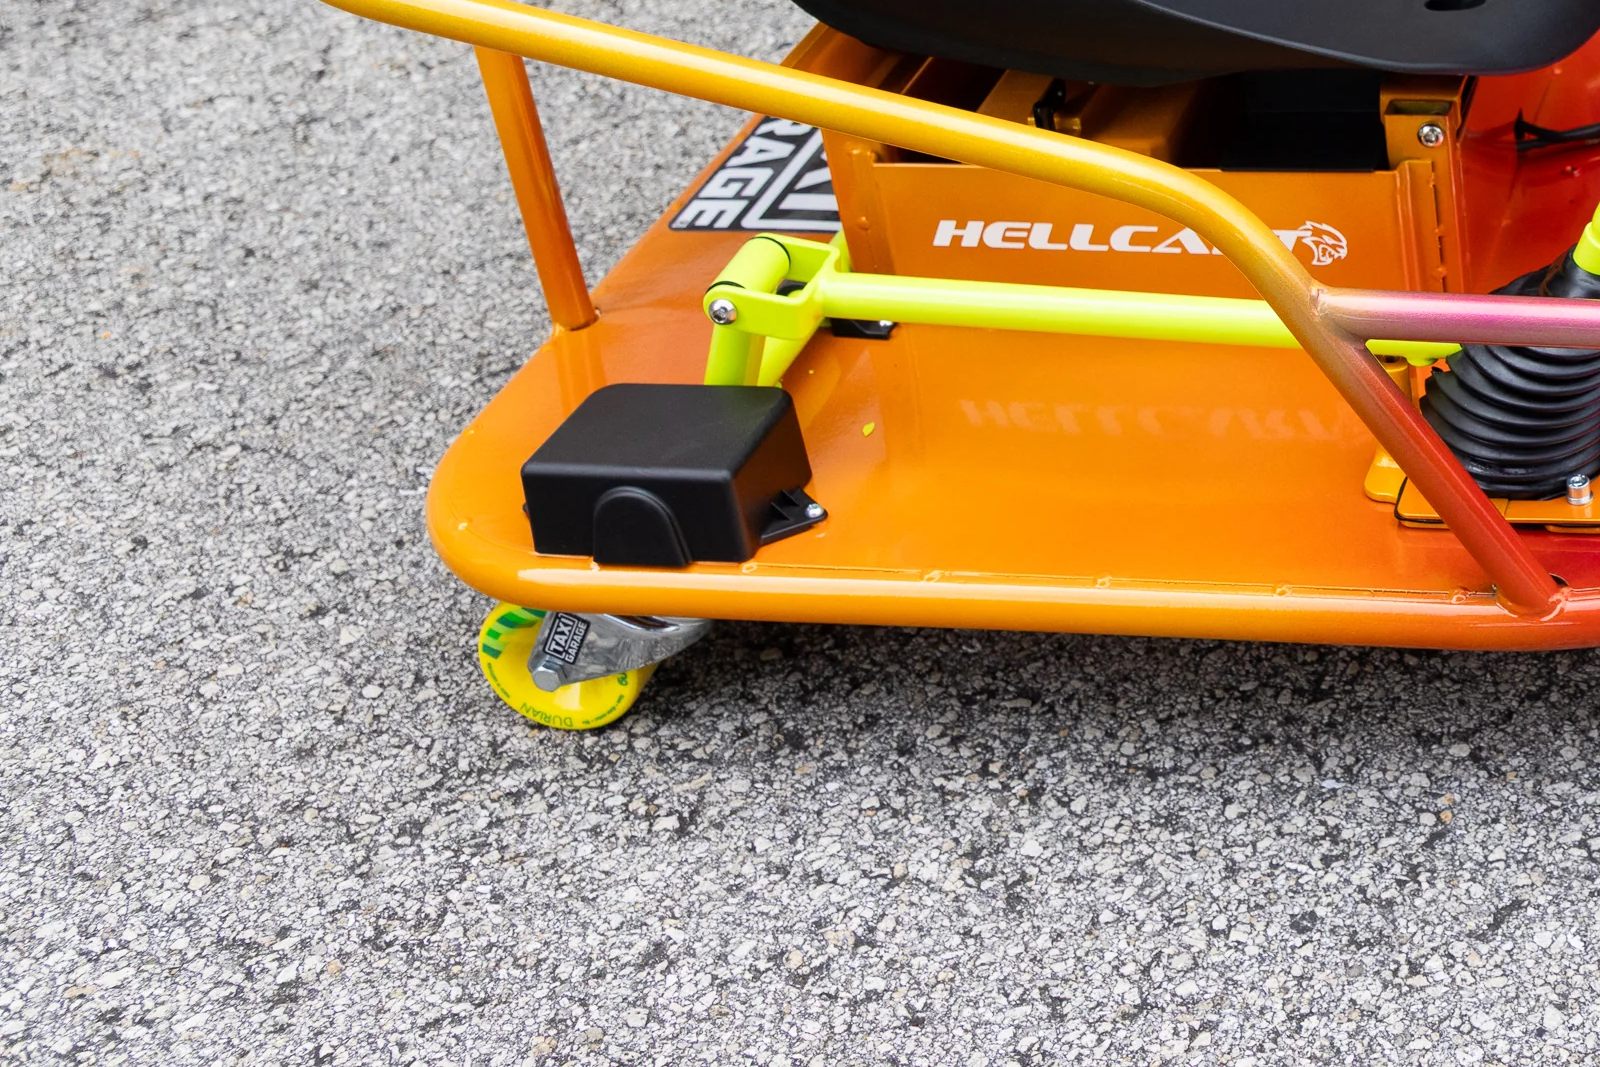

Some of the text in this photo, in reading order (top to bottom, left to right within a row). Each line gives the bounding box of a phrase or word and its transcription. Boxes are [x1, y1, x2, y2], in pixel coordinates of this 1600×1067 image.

[671, 119, 814, 229] RAGE
[932, 219, 1313, 256] HELLCAT
[550, 617, 574, 652] TAXI
[565, 621, 588, 663] GARAGE
[520, 702, 574, 728] DURIAN
